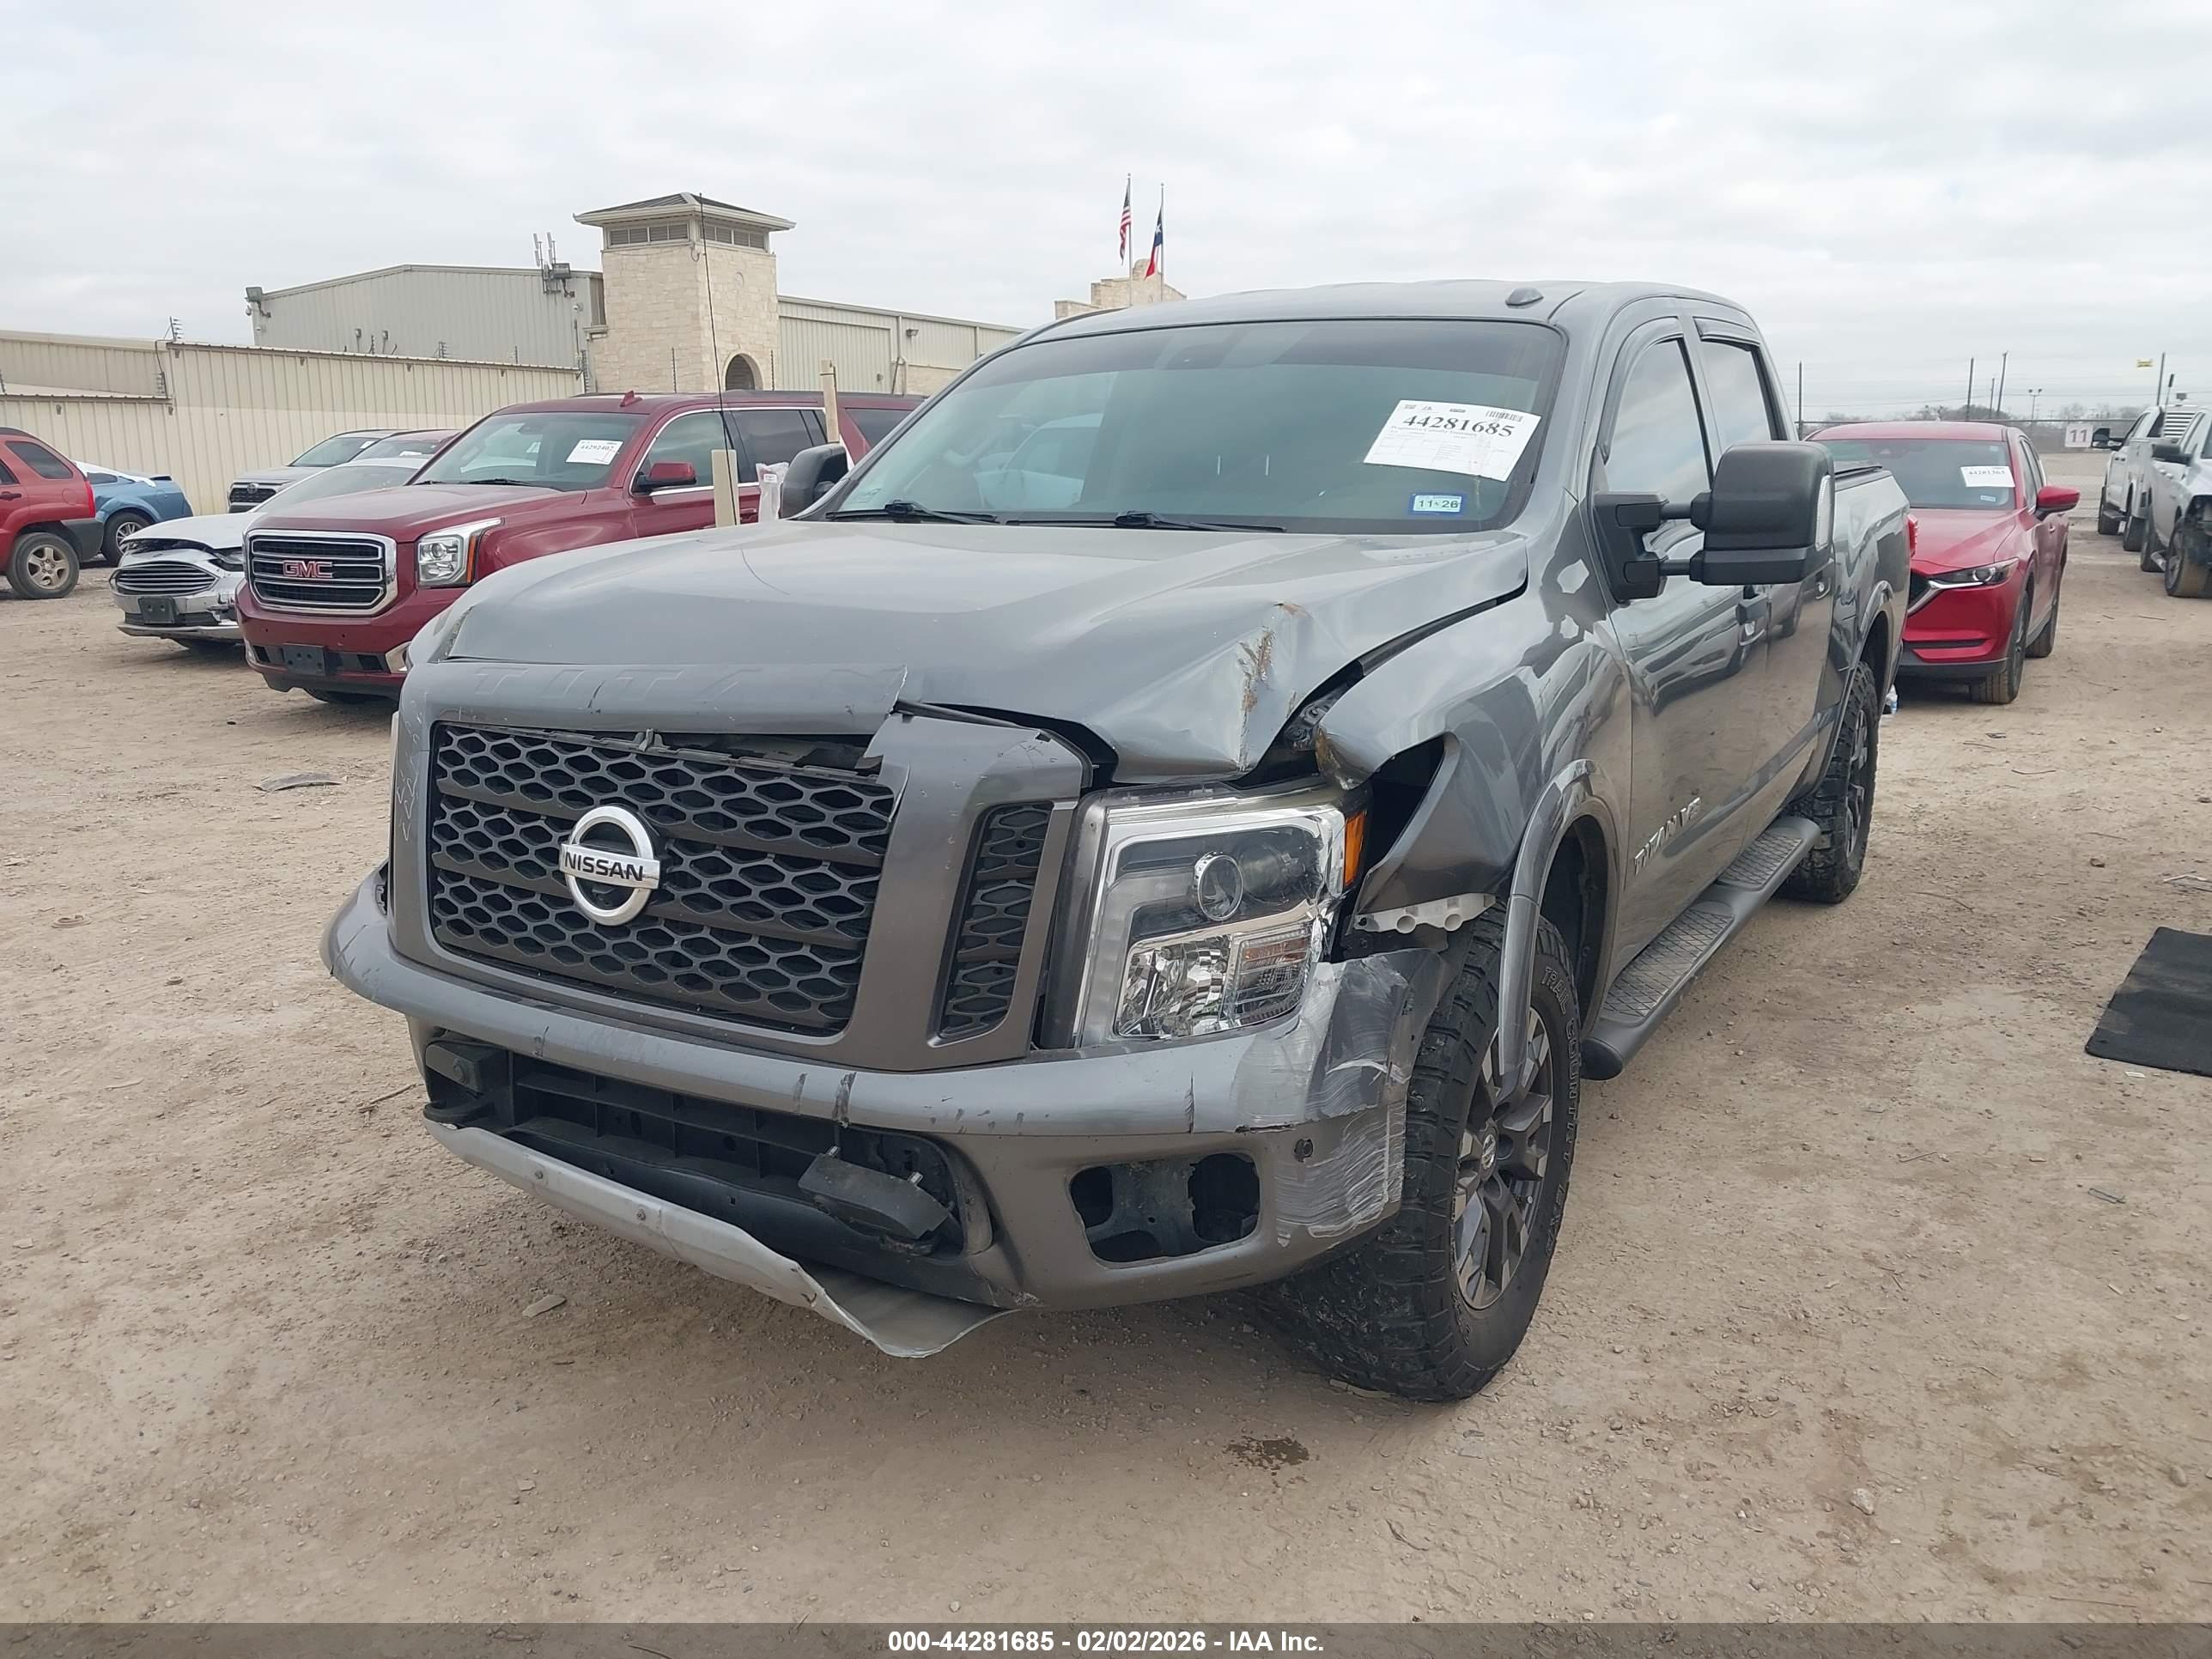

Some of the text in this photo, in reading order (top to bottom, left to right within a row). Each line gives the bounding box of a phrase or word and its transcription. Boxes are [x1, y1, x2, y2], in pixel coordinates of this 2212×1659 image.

[1402, 414, 1516, 438] 44281685
[2069, 428, 2087, 443] 11
[283, 559, 333, 579] GMC
[565, 852, 643, 882] NISSAN
[1540, 966, 1568, 1015] TRAIL
